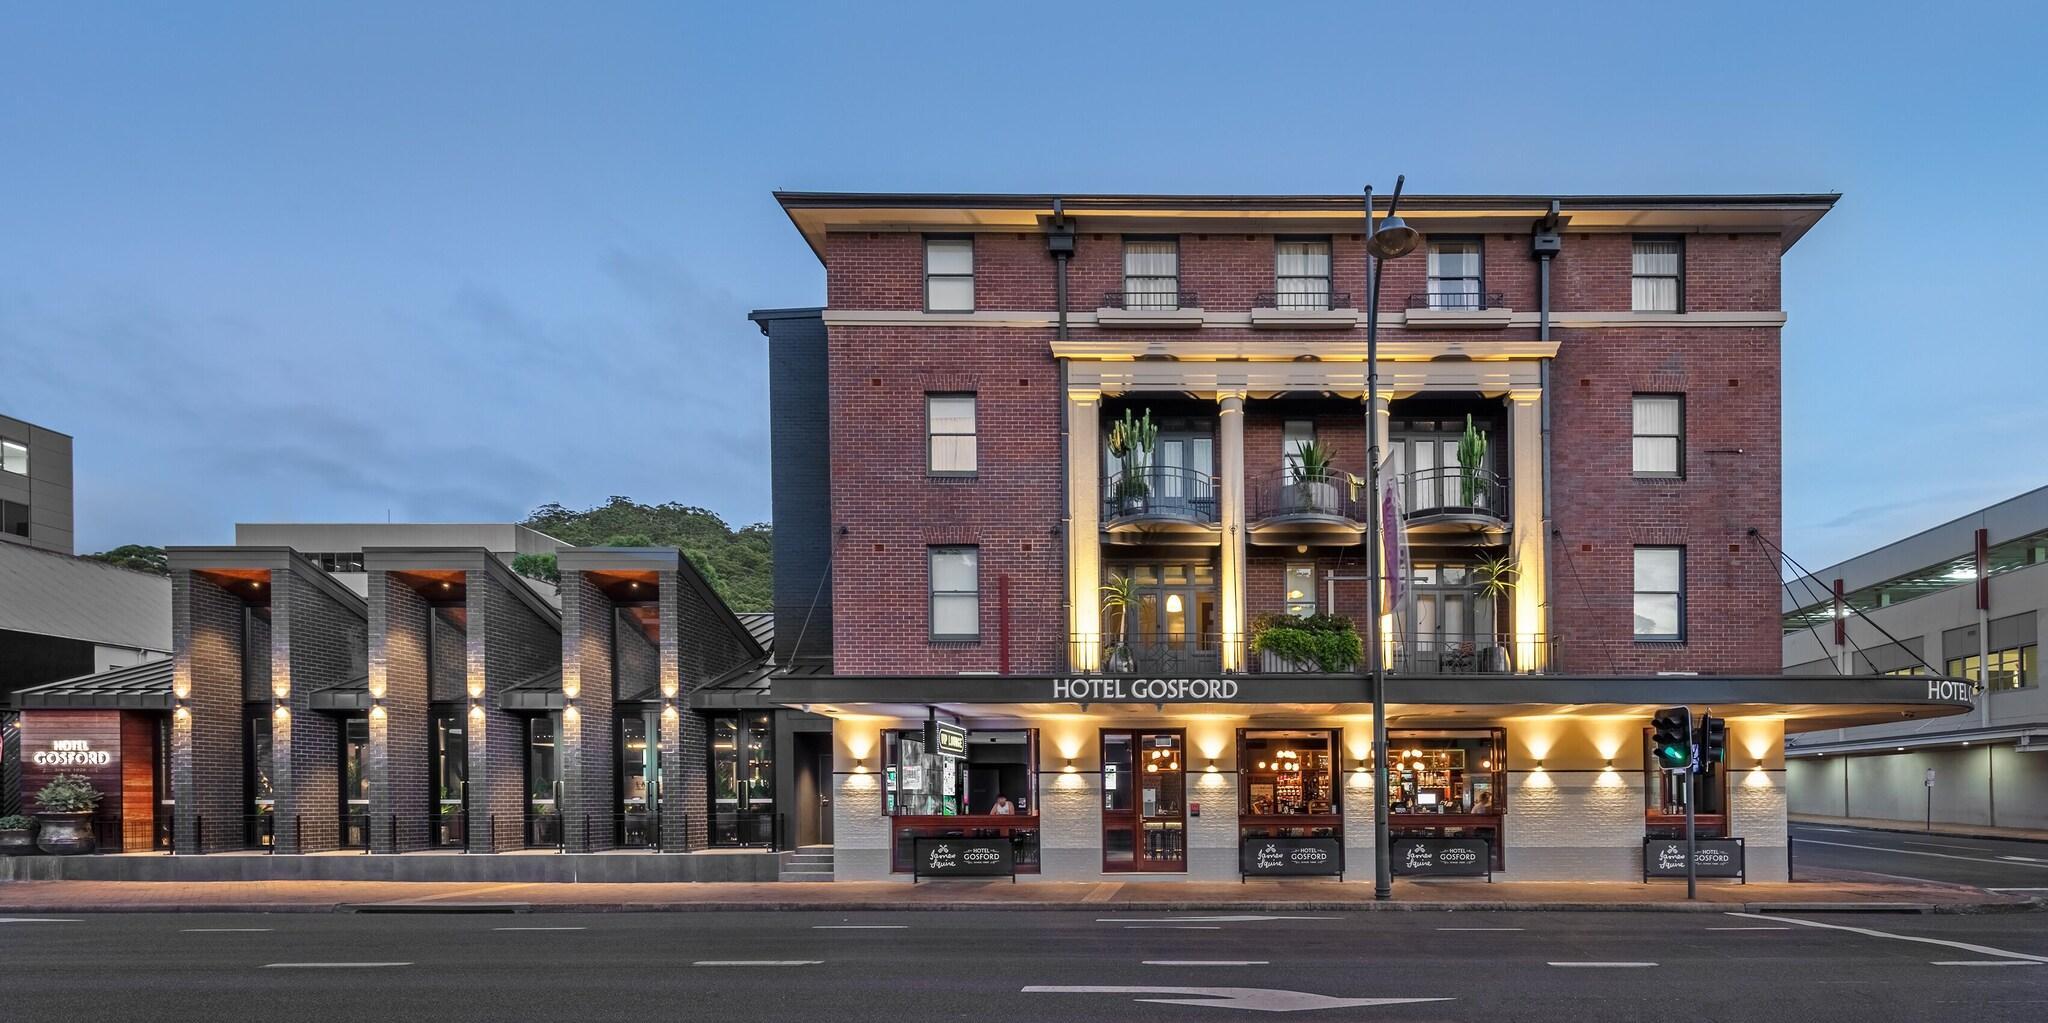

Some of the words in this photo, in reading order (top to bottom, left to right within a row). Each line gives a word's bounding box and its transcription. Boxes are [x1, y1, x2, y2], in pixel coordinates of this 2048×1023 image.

[1053, 679, 1126, 699] HOTEL
[1131, 679, 1238, 699] GOSFORD
[1927, 680, 1969, 701] HOTEL
[53, 740, 90, 751] HOTEL
[33, 751, 110, 765] GOSFORD
[963, 853, 1000, 861] GOSFORD
[1291, 853, 1327, 861] GOSFORD
[1440, 853, 1476, 861] GOSFORD
